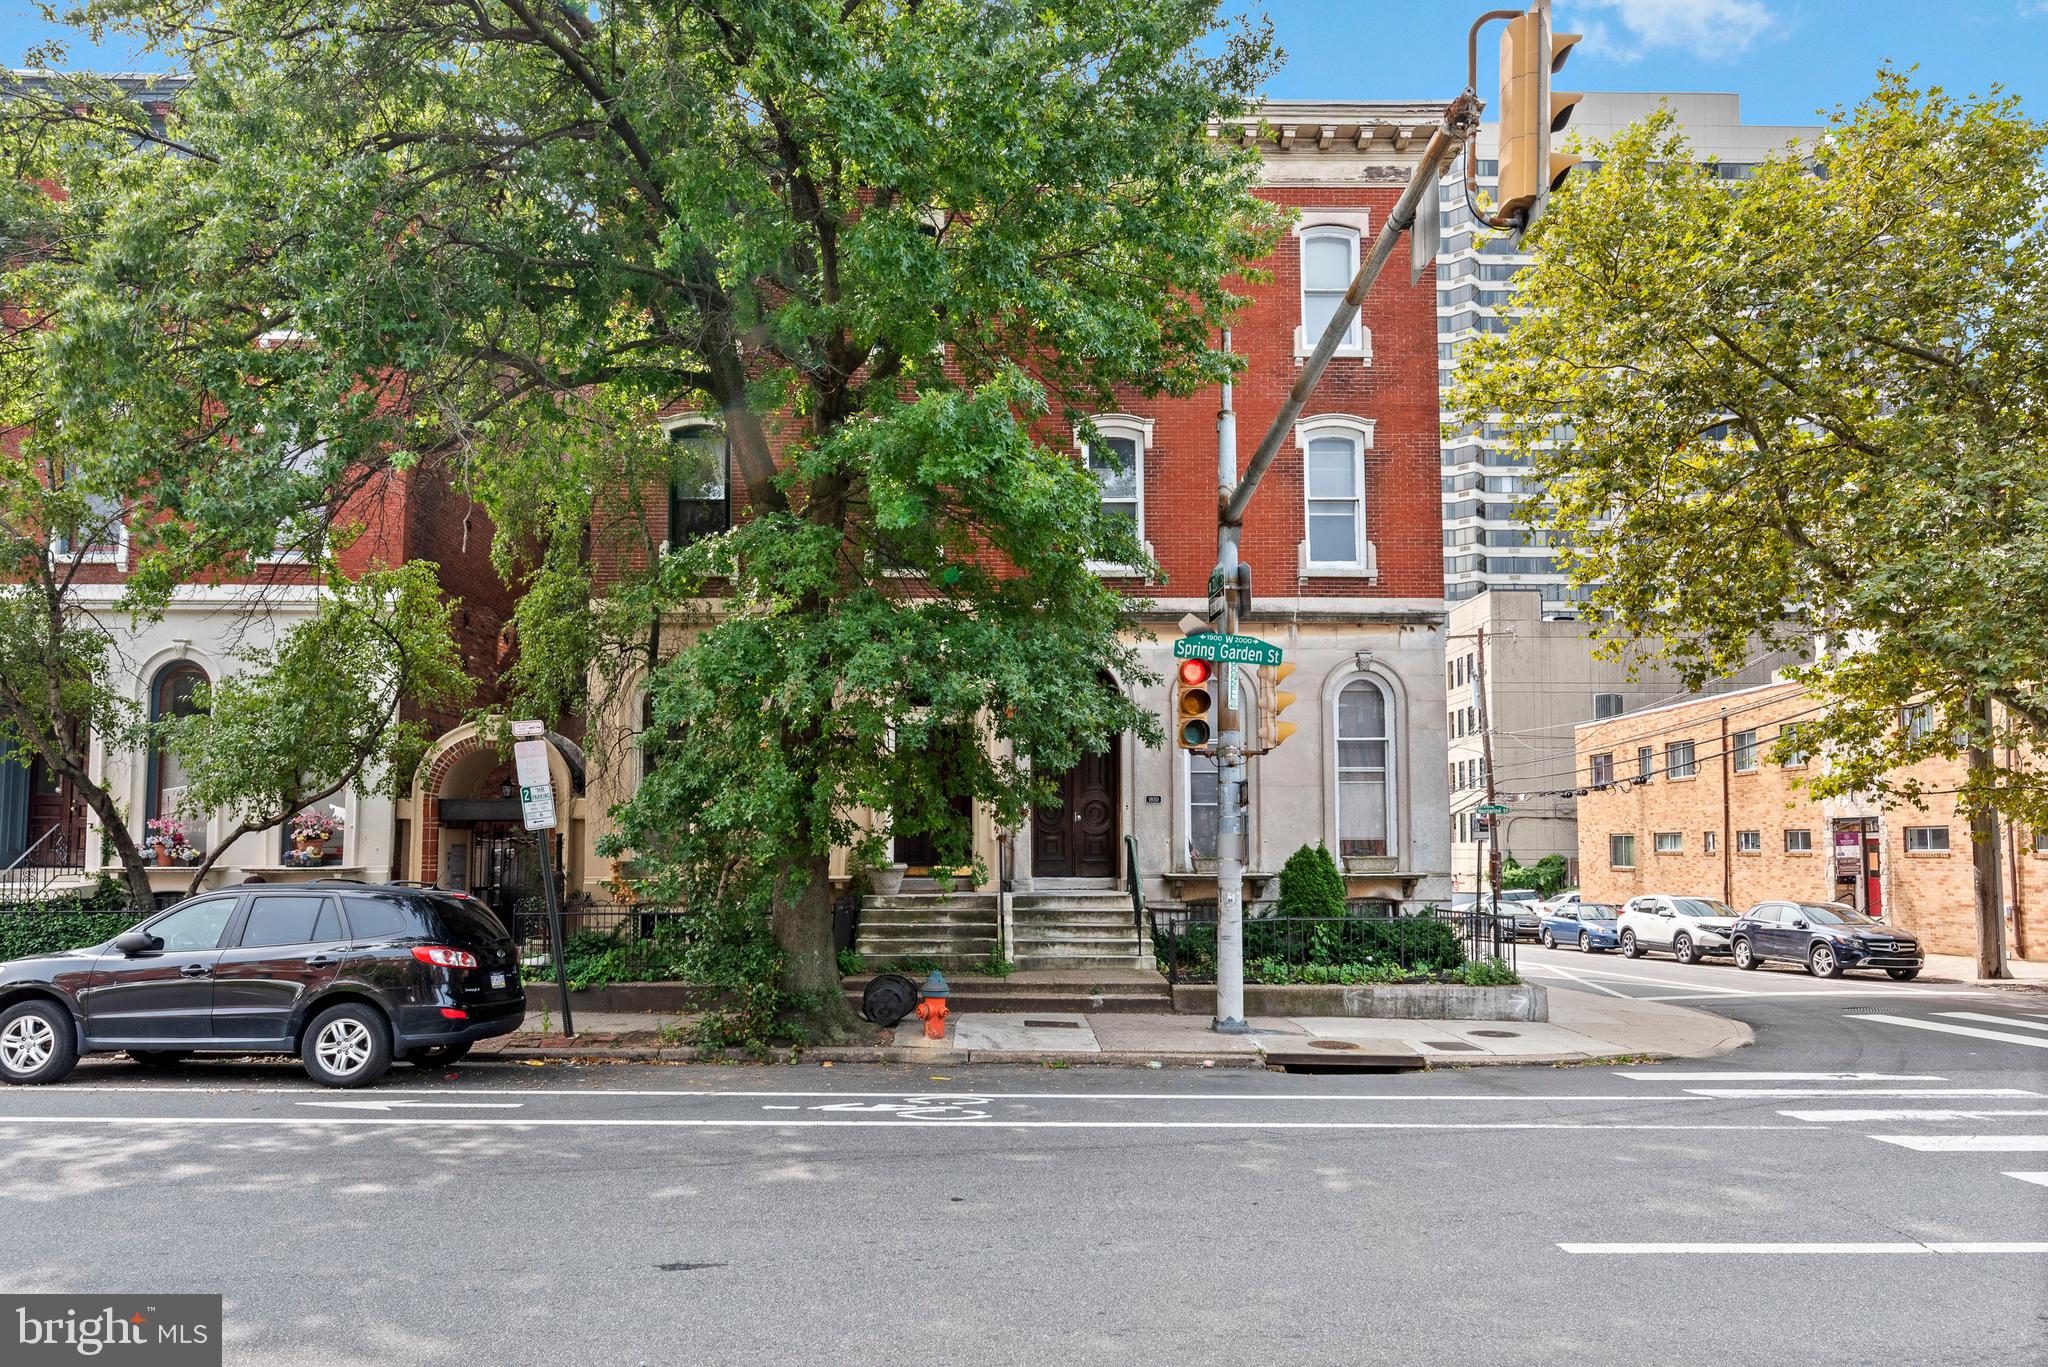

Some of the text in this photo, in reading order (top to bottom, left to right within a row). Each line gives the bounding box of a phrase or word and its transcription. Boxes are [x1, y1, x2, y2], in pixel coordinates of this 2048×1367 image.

[1225, 635, 1234, 644] W
[1234, 636, 1253, 644] 2000
[1177, 640, 1280, 664] Spring Garden St
[523, 789, 531, 801] 2
